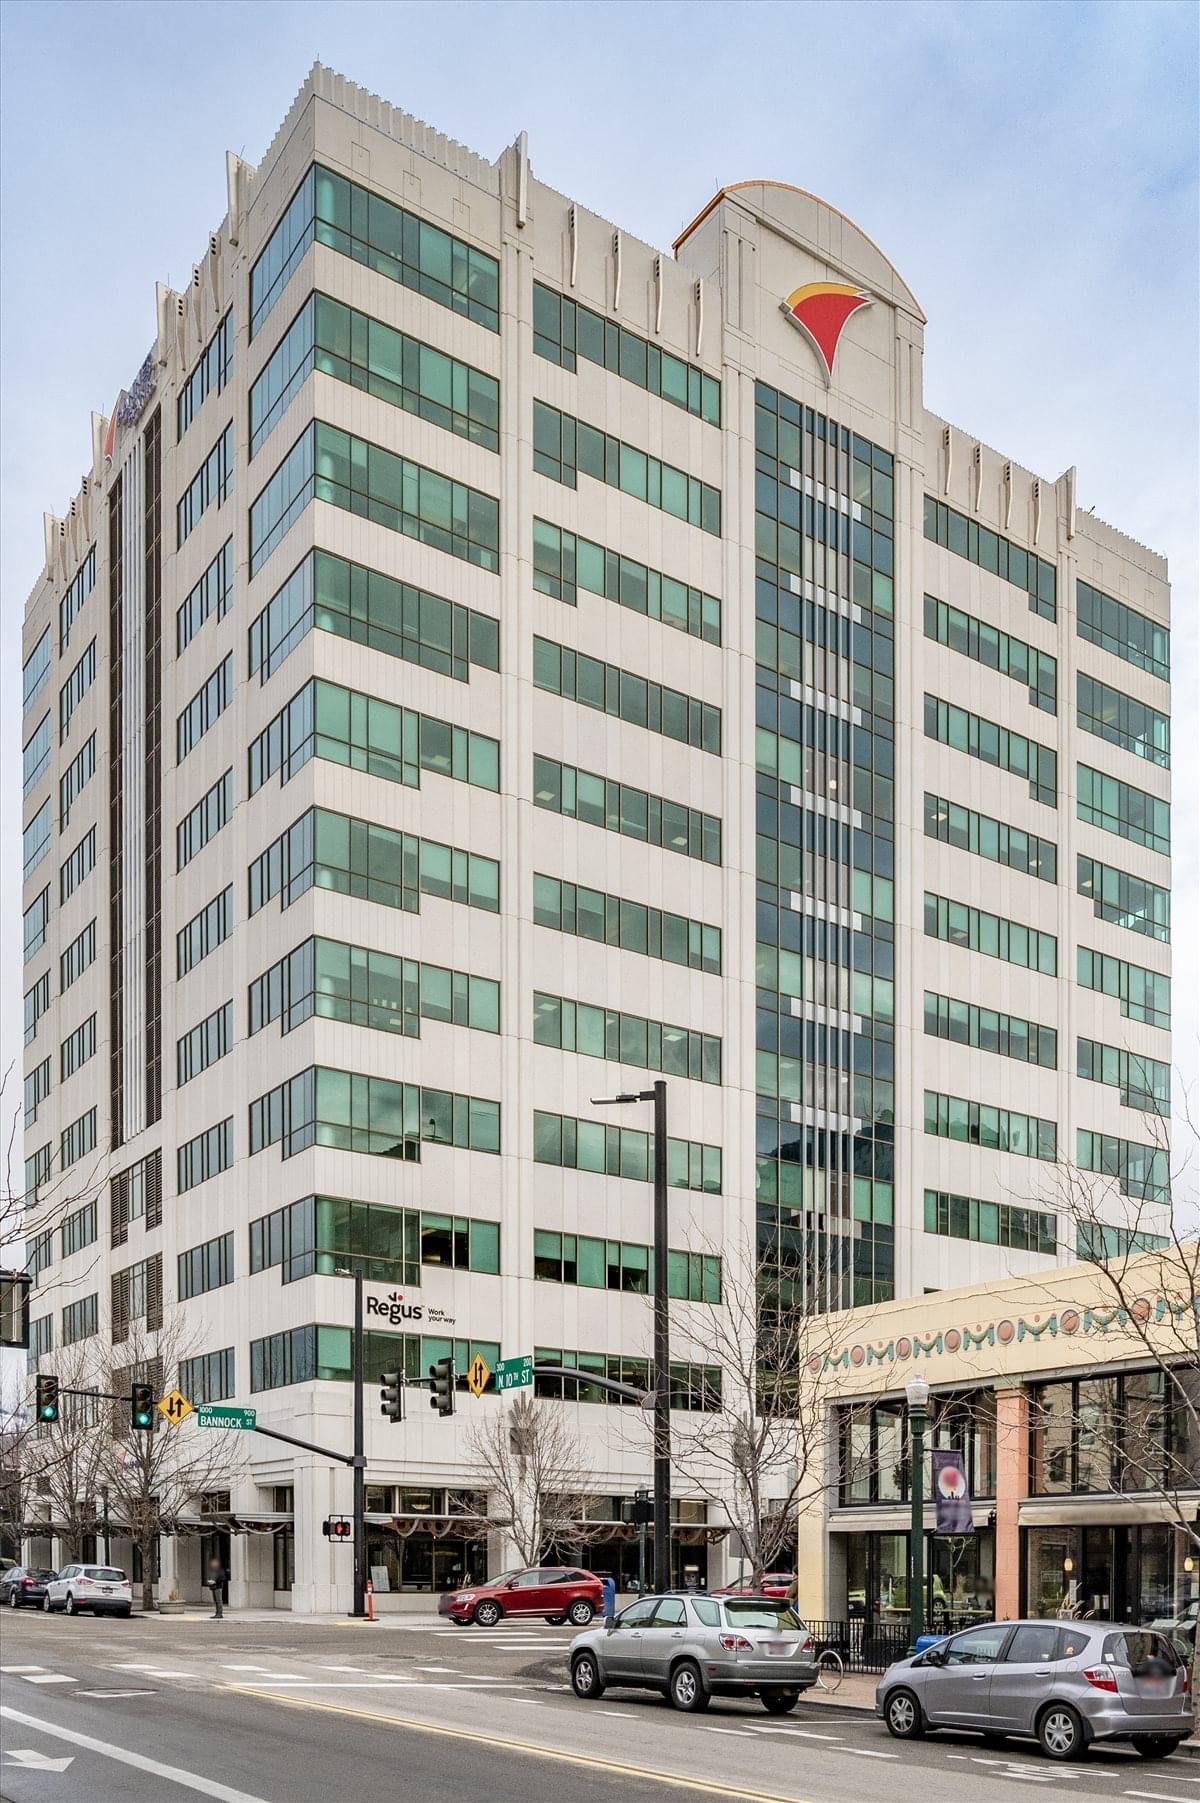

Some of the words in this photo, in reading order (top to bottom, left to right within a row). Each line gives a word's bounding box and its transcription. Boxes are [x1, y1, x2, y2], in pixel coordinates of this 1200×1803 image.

[366, 1295, 423, 1325] Regus
[428, 1308, 445, 1316] Work
[498, 1374, 504, 1388] N
[521, 1369, 530, 1384] ST
[199, 1406, 213, 1414] 1000
[243, 1409, 255, 1417] 900
[200, 1415, 242, 1428] BANNOCK
[245, 1418, 253, 1426] ST
